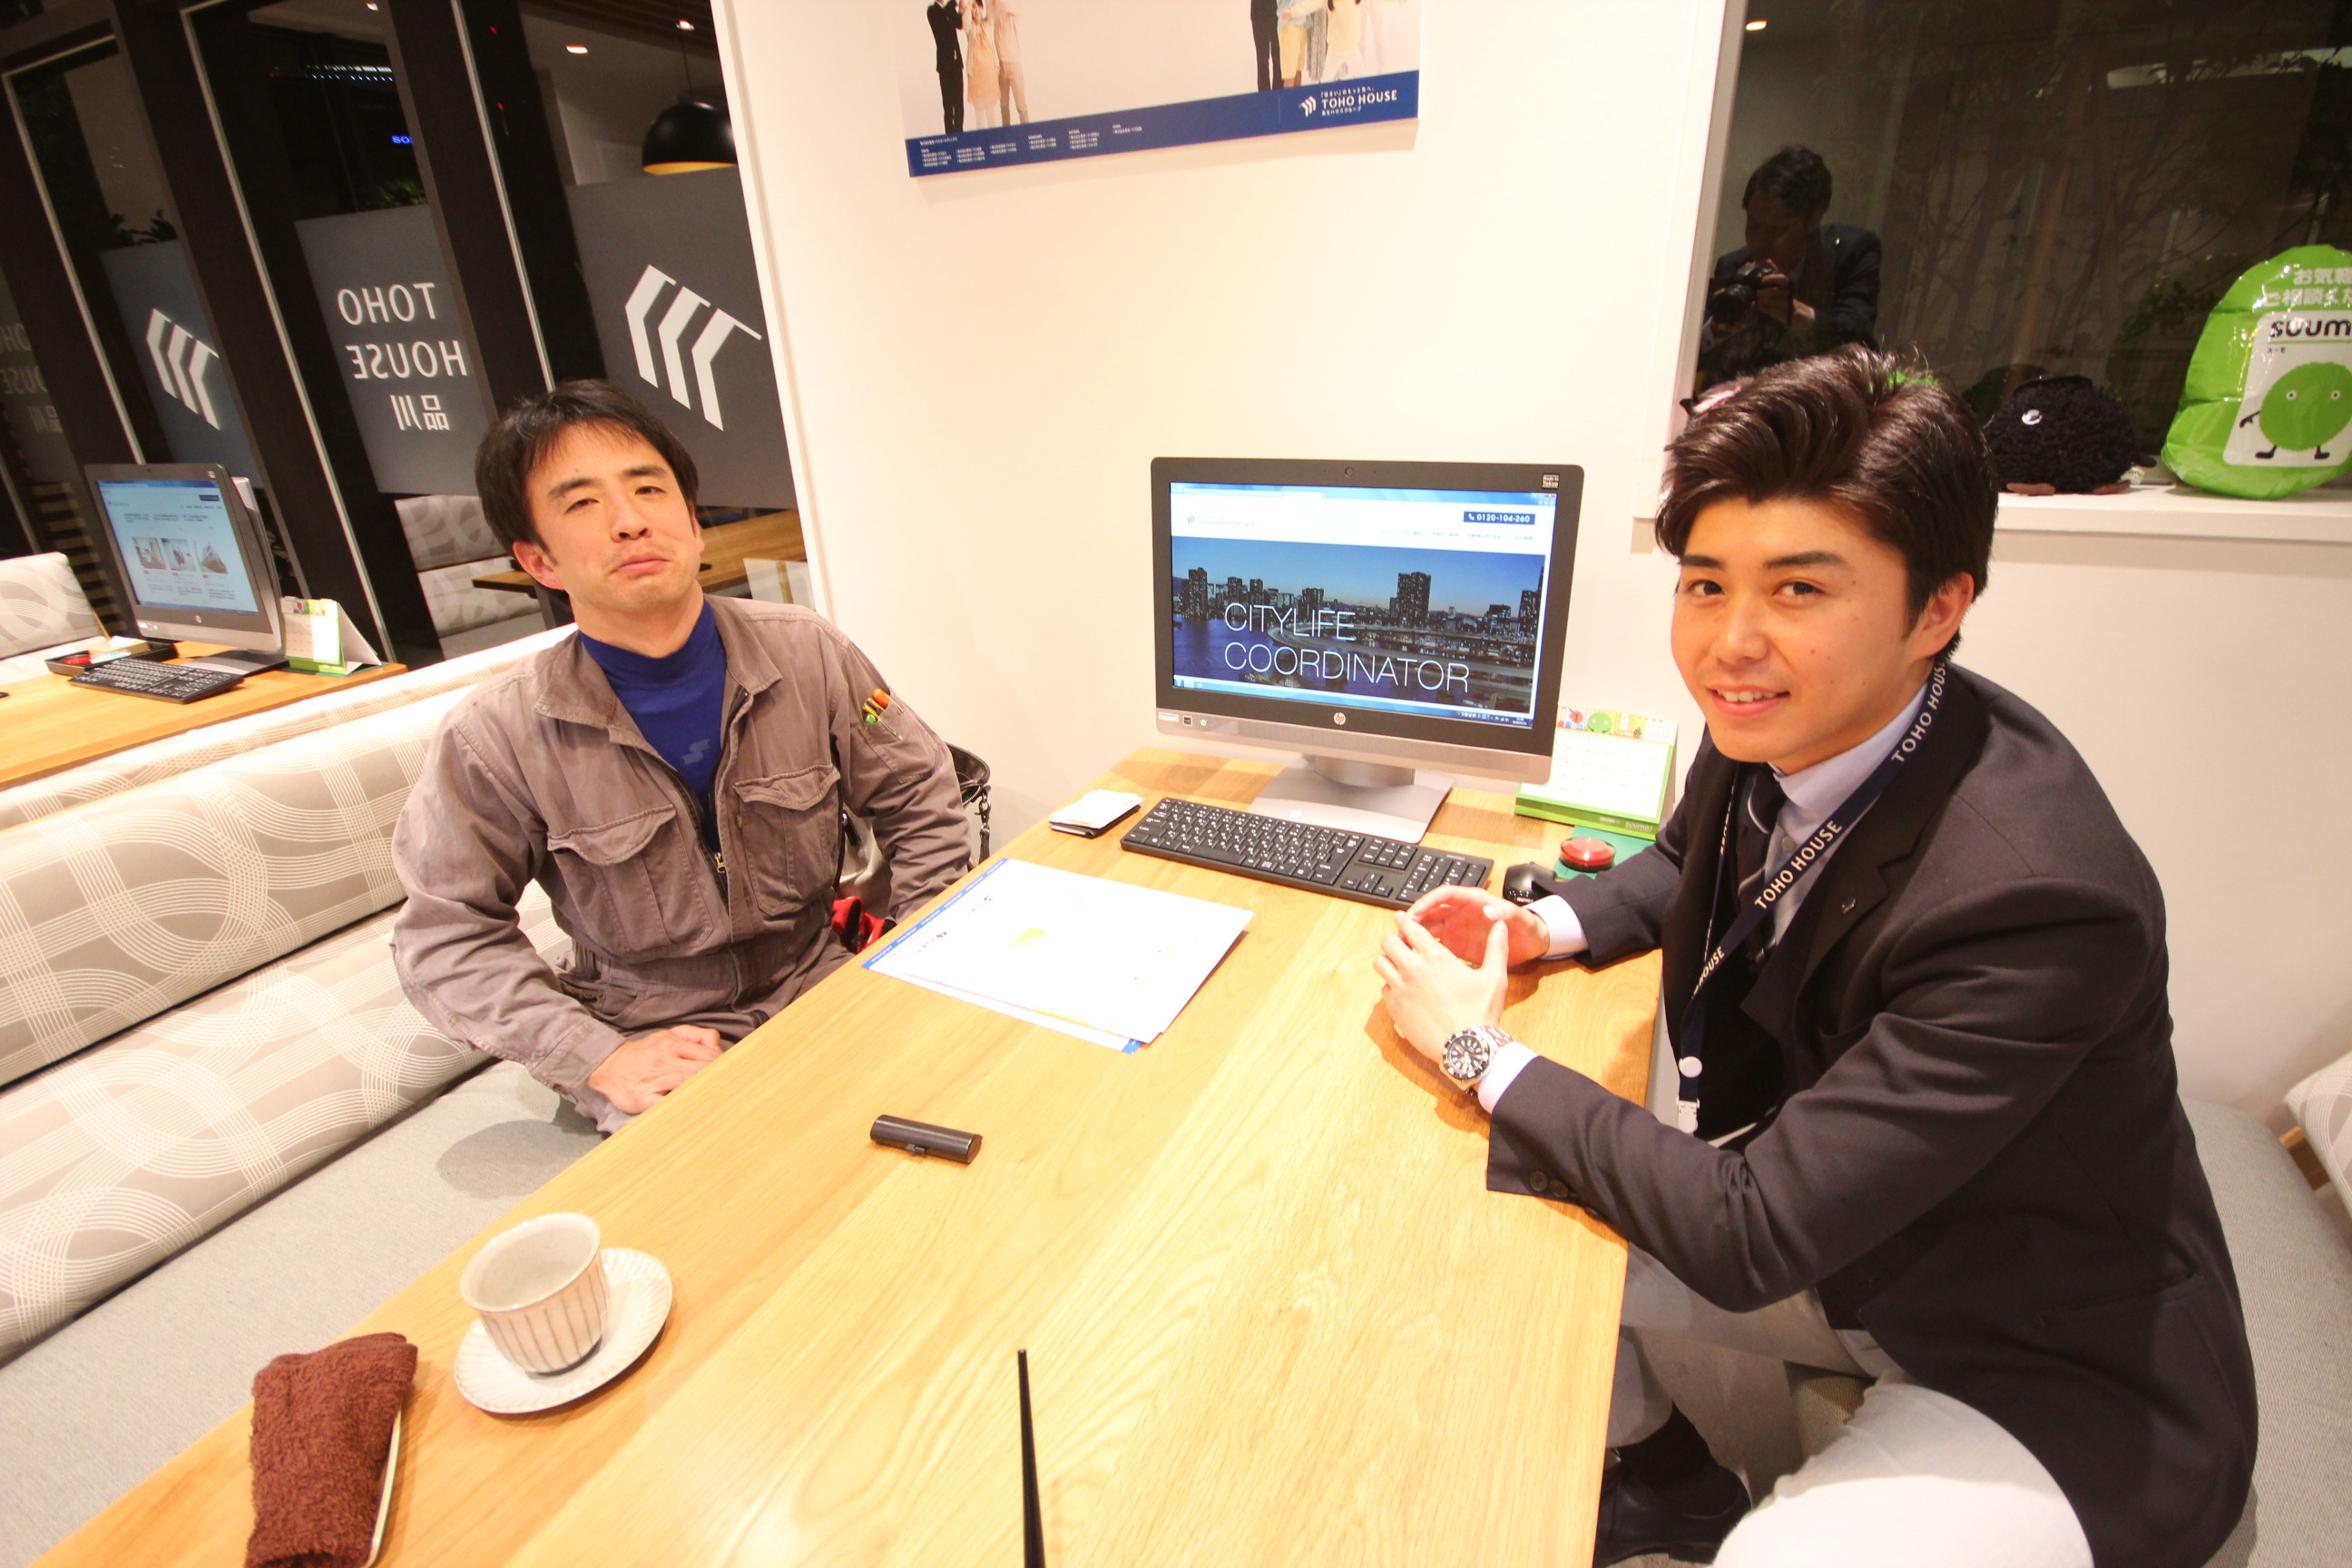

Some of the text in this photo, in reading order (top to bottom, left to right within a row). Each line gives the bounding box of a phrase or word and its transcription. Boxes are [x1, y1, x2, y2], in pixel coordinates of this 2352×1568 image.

[1321, 90, 1397, 110] TOHO HOUSE
[1225, 603, 1357, 641] CITYLIFE
[1225, 642, 1471, 693] COORDINATOR
[1891, 711, 1932, 762] TOHO
[1754, 820, 1843, 909] TOHO HOUSE
